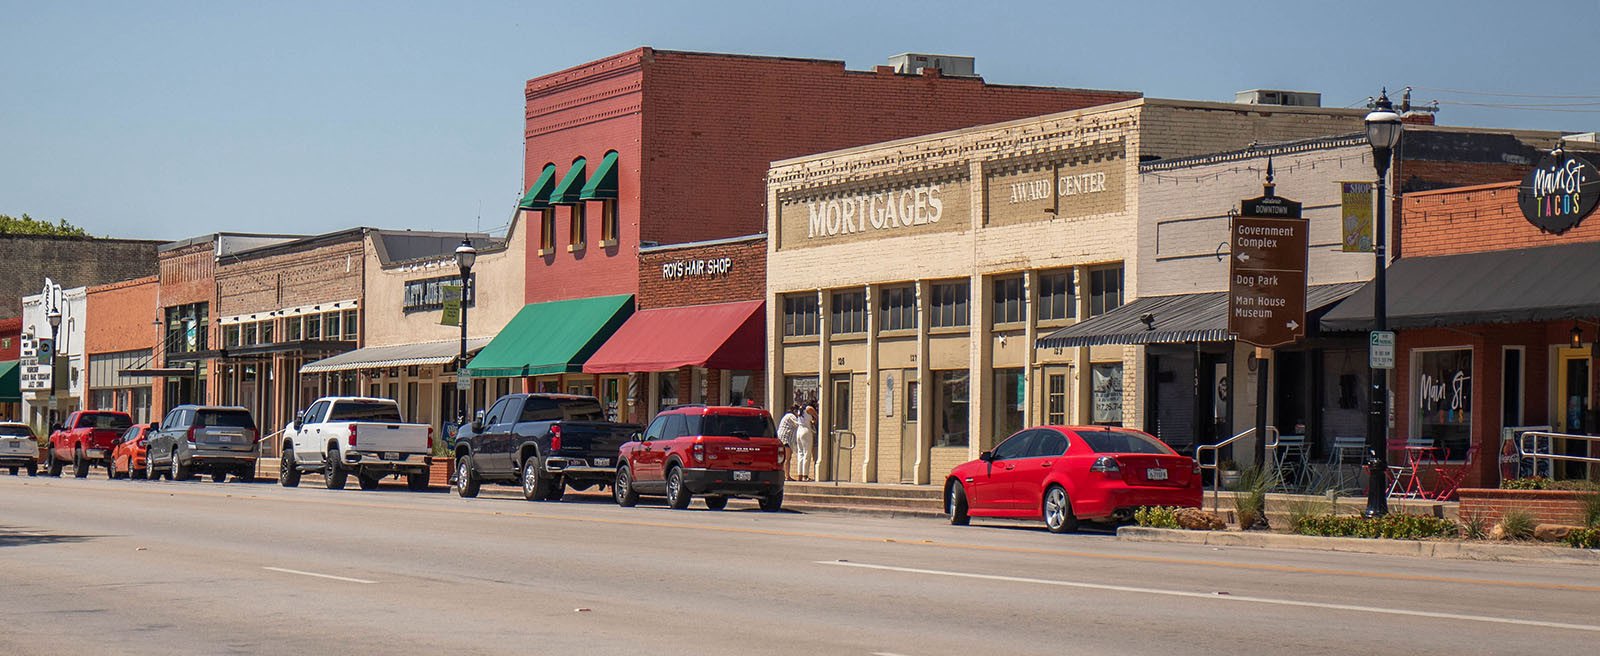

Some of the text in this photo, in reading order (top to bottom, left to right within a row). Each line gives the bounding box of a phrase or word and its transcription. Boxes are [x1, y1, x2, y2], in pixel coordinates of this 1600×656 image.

[1534, 159, 1585, 198] Main St.
[1009, 172, 1106, 204] AWARD CENTER
[1350, 183, 1371, 193] SHOP
[808, 184, 943, 239] MORTGAGES
[1255, 205, 1288, 215] DOWNTOWN
[1536, 193, 1580, 218] TACOS
[1238, 225, 1294, 236] Government
[1237, 237, 1278, 249] Complex
[663, 258, 732, 279] ROY'S HAIR SHOP
[1236, 275, 1279, 287] Dog Park
[1235, 296, 1286, 307] Man House
[1235, 308, 1273, 318] Museum
[1420, 370, 1471, 411] Main St.
